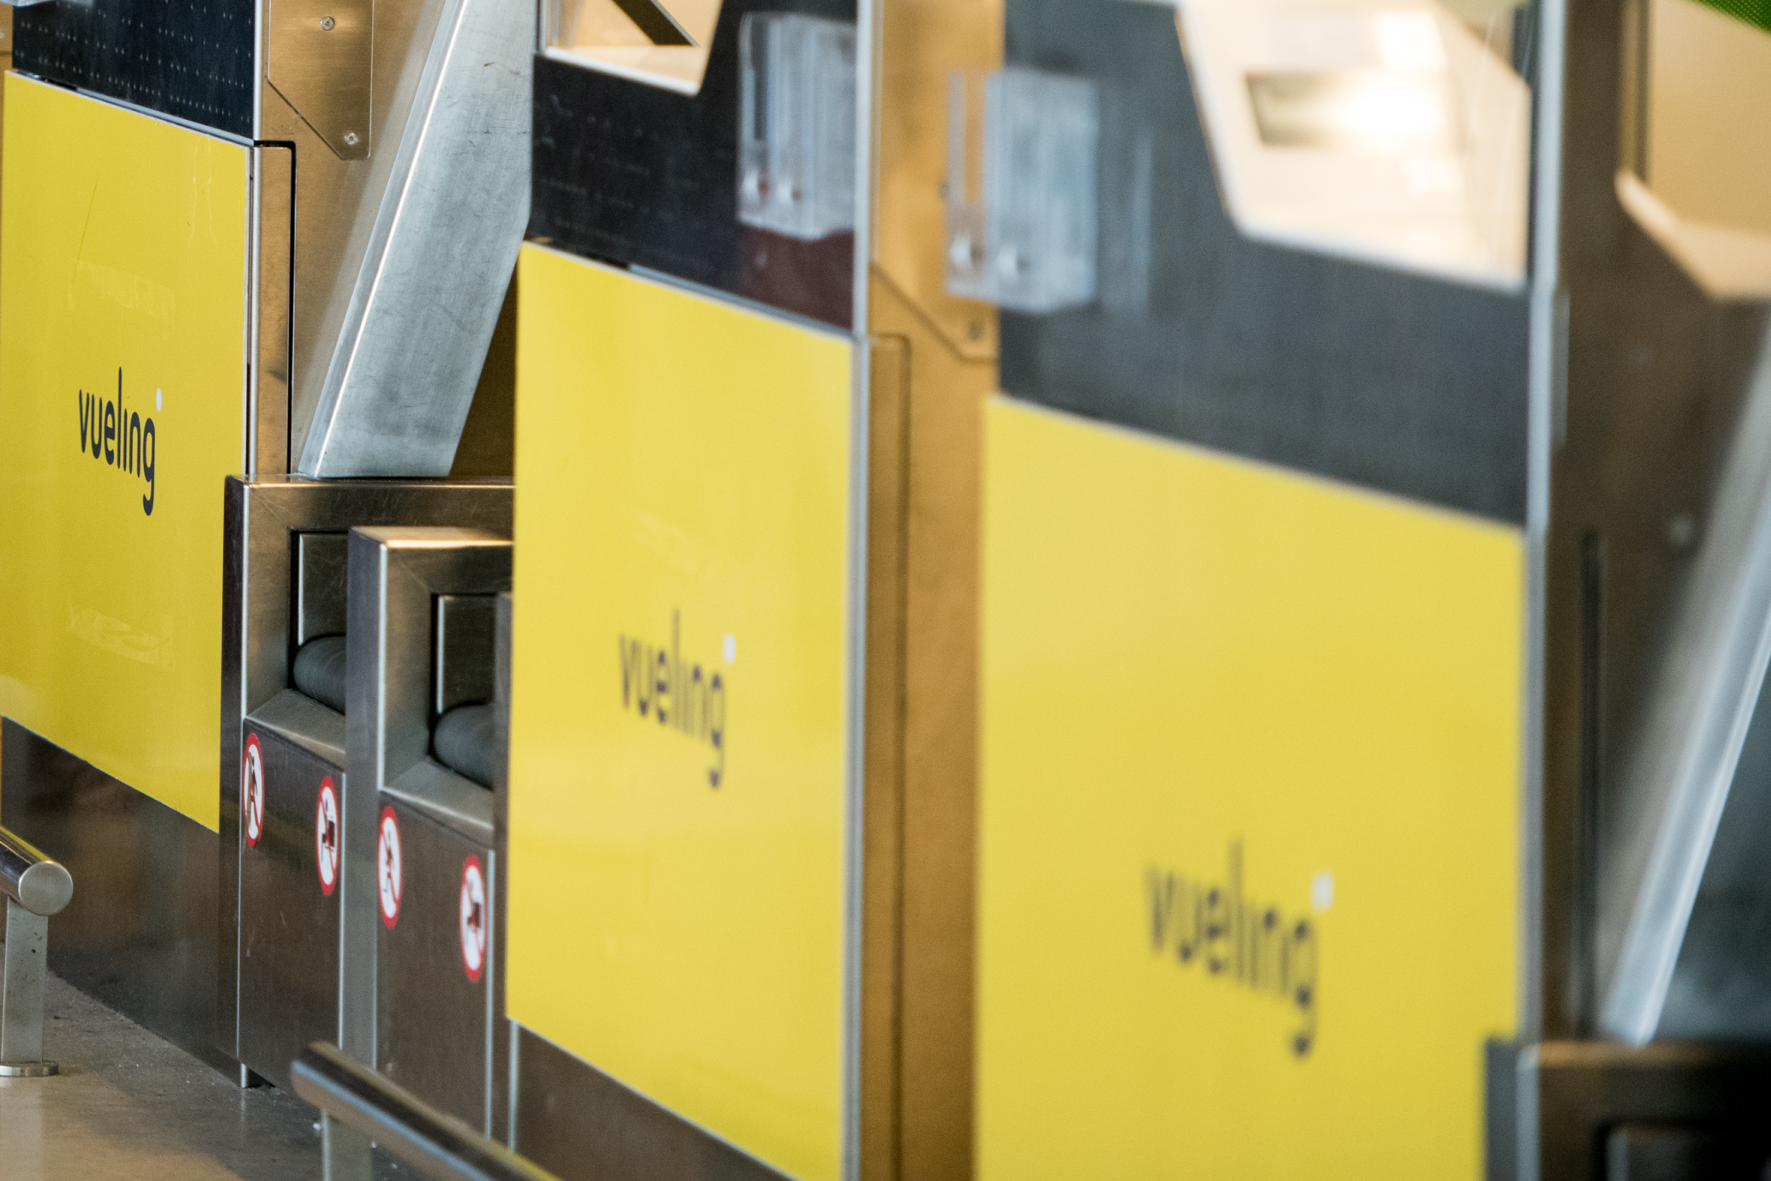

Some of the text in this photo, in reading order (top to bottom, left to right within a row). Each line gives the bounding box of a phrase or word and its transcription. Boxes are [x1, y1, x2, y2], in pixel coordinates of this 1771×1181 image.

[79, 367, 162, 516] vueling
[619, 607, 736, 790] vueling
[1142, 836, 1334, 1060] vueling
